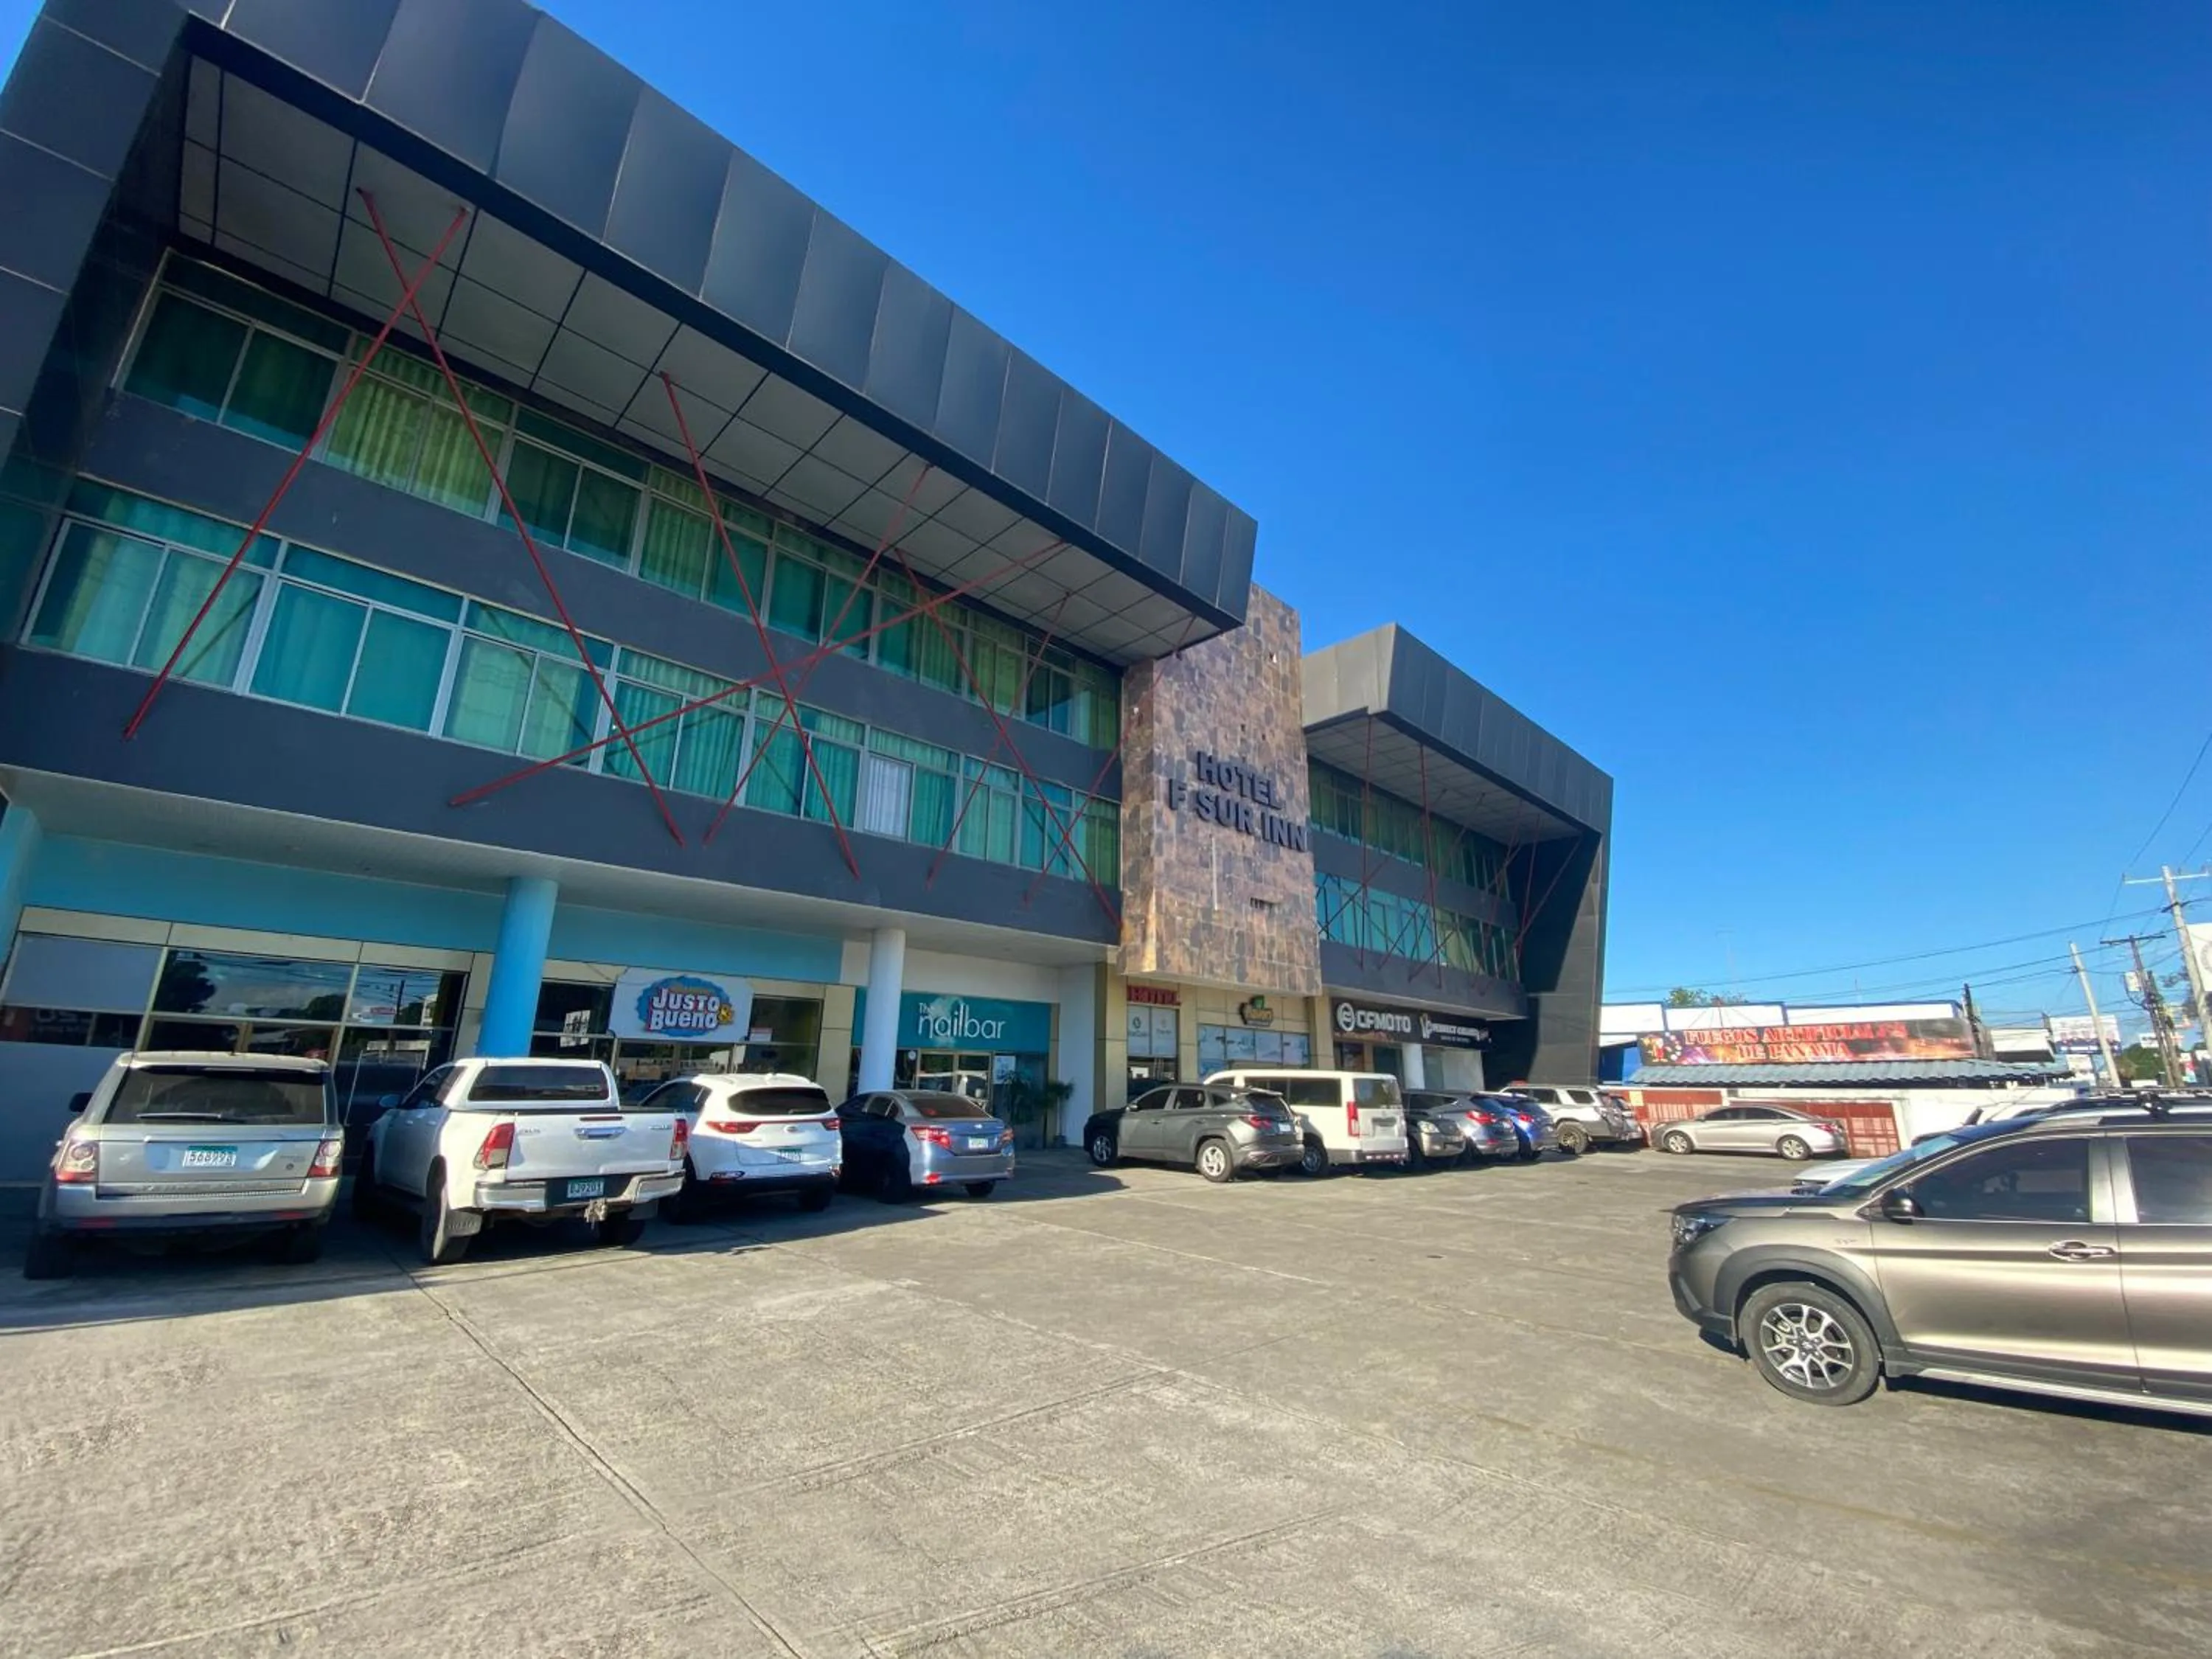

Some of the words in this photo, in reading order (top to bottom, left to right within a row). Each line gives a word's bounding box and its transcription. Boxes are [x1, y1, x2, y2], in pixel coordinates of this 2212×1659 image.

[1197, 751, 1283, 810] HOTEL
[1196, 789, 1256, 835] SUR
[1261, 812, 1307, 853] INN
[1357, 1010, 1412, 1033] CFMOTO
[1684, 1029, 1759, 1045] FUEGOS
[1737, 1045, 1767, 1060] DE
